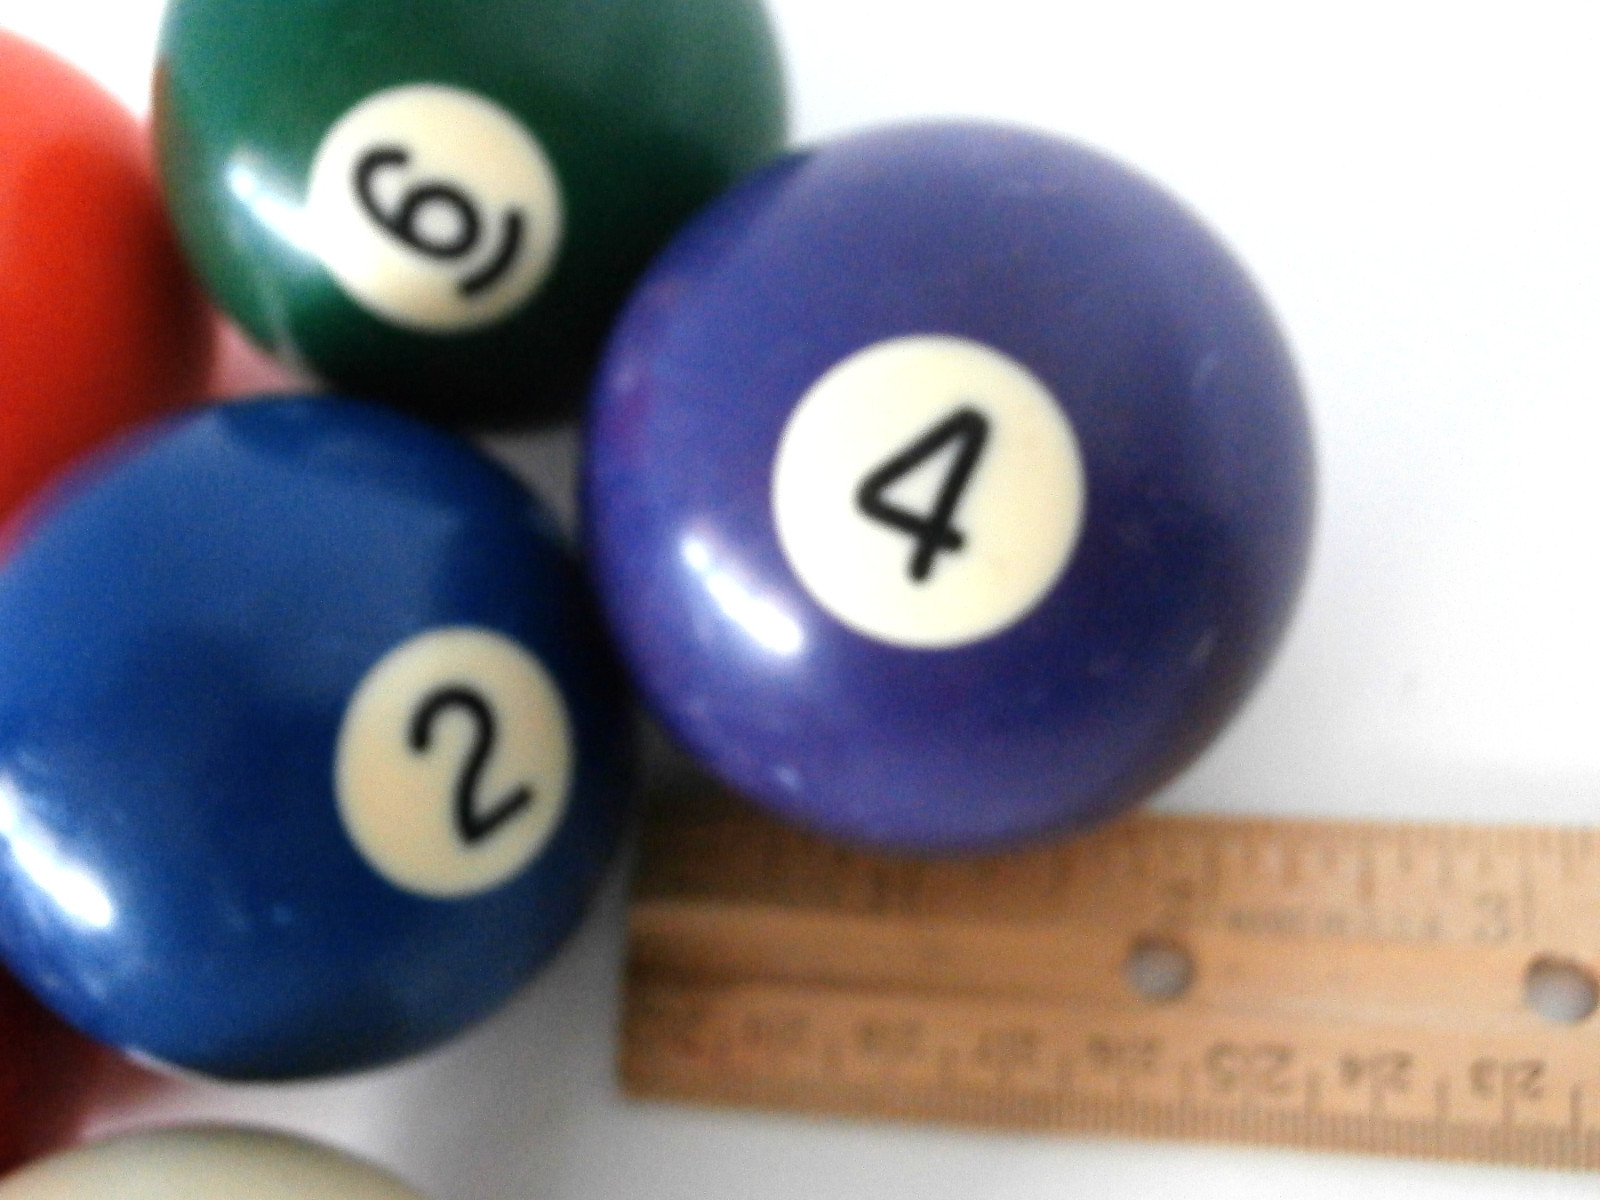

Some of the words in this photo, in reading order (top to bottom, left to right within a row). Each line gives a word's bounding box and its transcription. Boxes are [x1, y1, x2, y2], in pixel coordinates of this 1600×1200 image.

[352, 146, 485, 264] 6
[856, 405, 992, 584] 4
[406, 682, 536, 848] 2
[1202, 1040, 1296, 1096] 25
[1337, 1048, 1416, 1094] 24
[1467, 1055, 1547, 1101] 23
